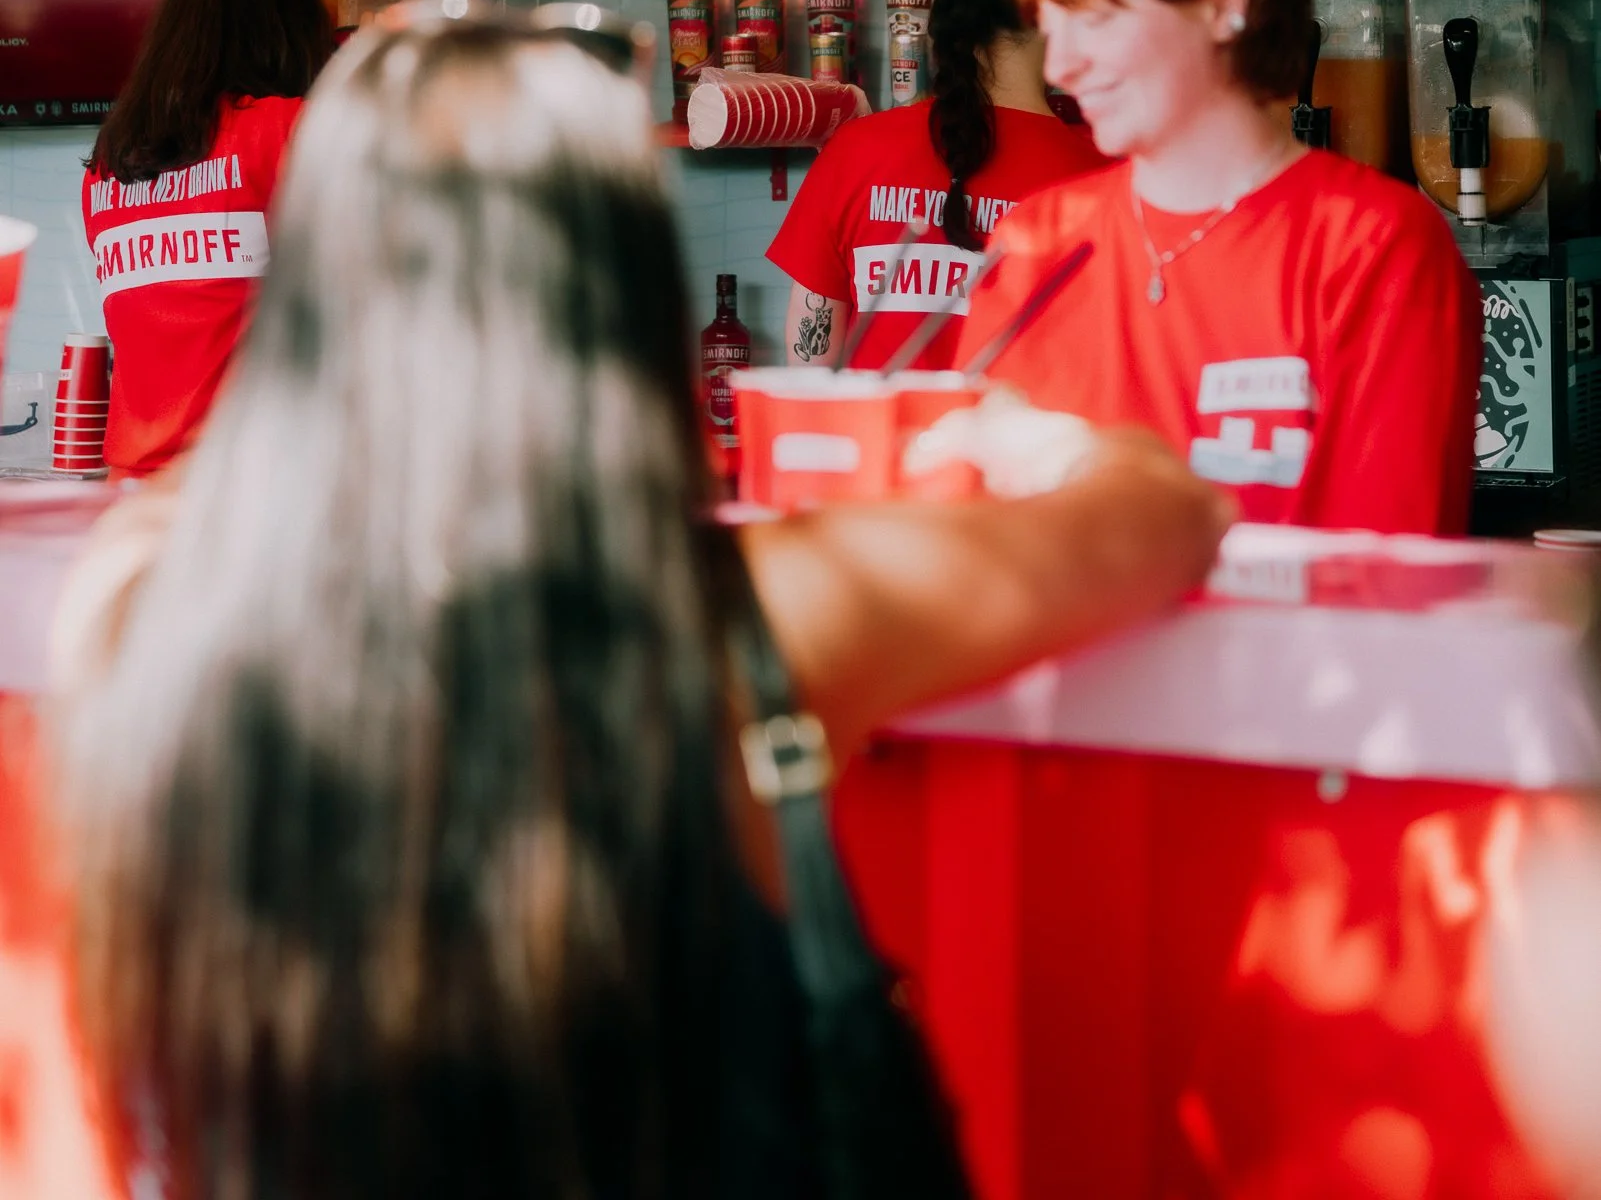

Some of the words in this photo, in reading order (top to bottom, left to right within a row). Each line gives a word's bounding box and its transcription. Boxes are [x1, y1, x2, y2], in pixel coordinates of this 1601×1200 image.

[738, 7, 775, 18] SMIRNOFF
[153, 168, 186, 203] NEXT
[189, 157, 227, 199] DRINK
[231, 154, 242, 188] A
[870, 185, 920, 223] MAKE
[703, 348, 748, 359] SMIRNOFF
